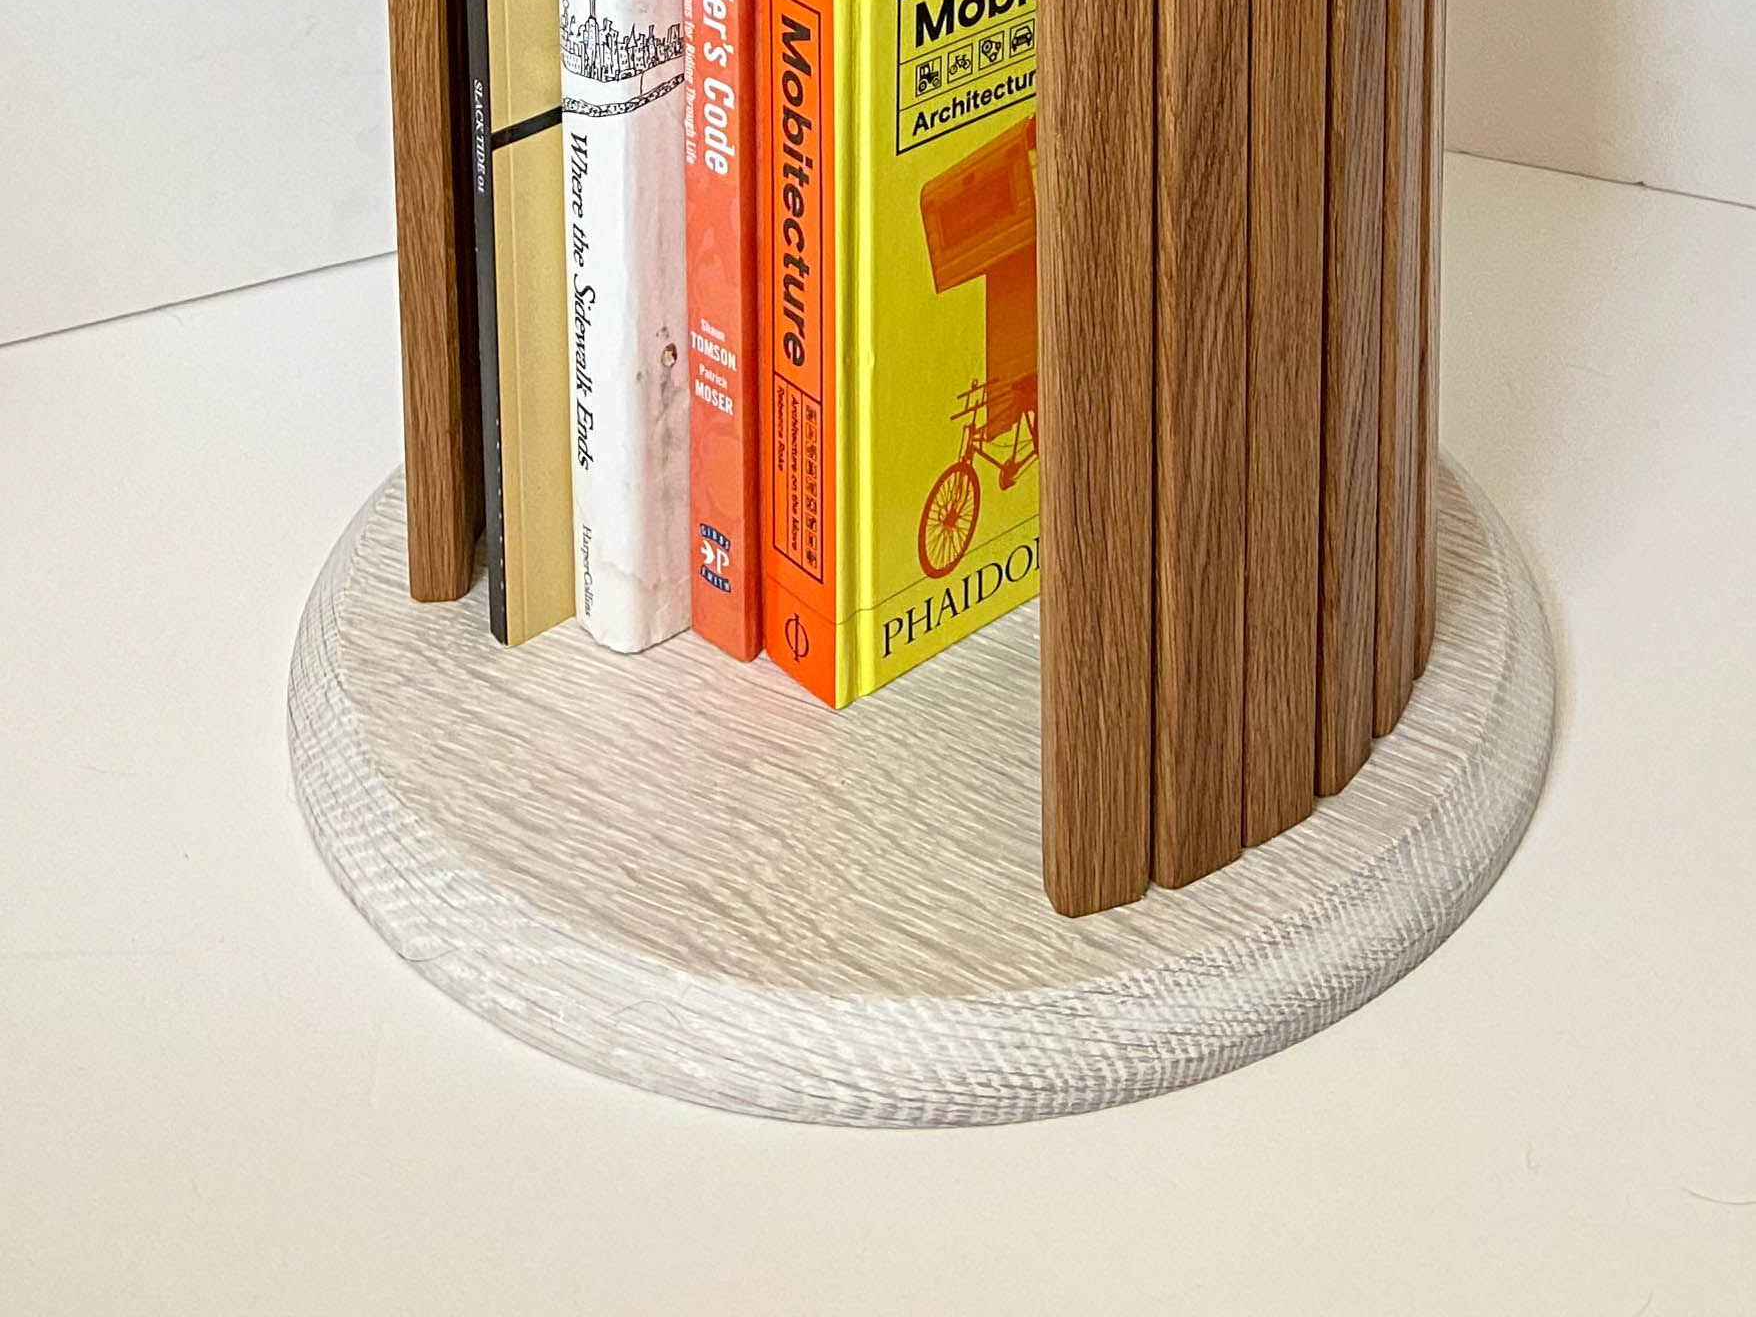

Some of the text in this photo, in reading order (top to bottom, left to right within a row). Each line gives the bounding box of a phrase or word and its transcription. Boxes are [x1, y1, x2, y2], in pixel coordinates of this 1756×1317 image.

[684, 21, 696, 40] for
[684, 42, 696, 85] Riding
[473, 78, 485, 132] SLACK
[684, 87, 697, 138] Through
[703, 76, 736, 176] Code
[475, 134, 486, 174] TIDE
[686, 140, 697, 165] Life
[781, 13, 813, 368] Mobitecture
[570, 132, 596, 470] Where the Sidewalk Ends
[690, 331, 737, 371] TOMSON
[695, 378, 734, 416] MOSER
[699, 364, 728, 390] Patrick
[581, 523, 594, 617] HarperCollins
